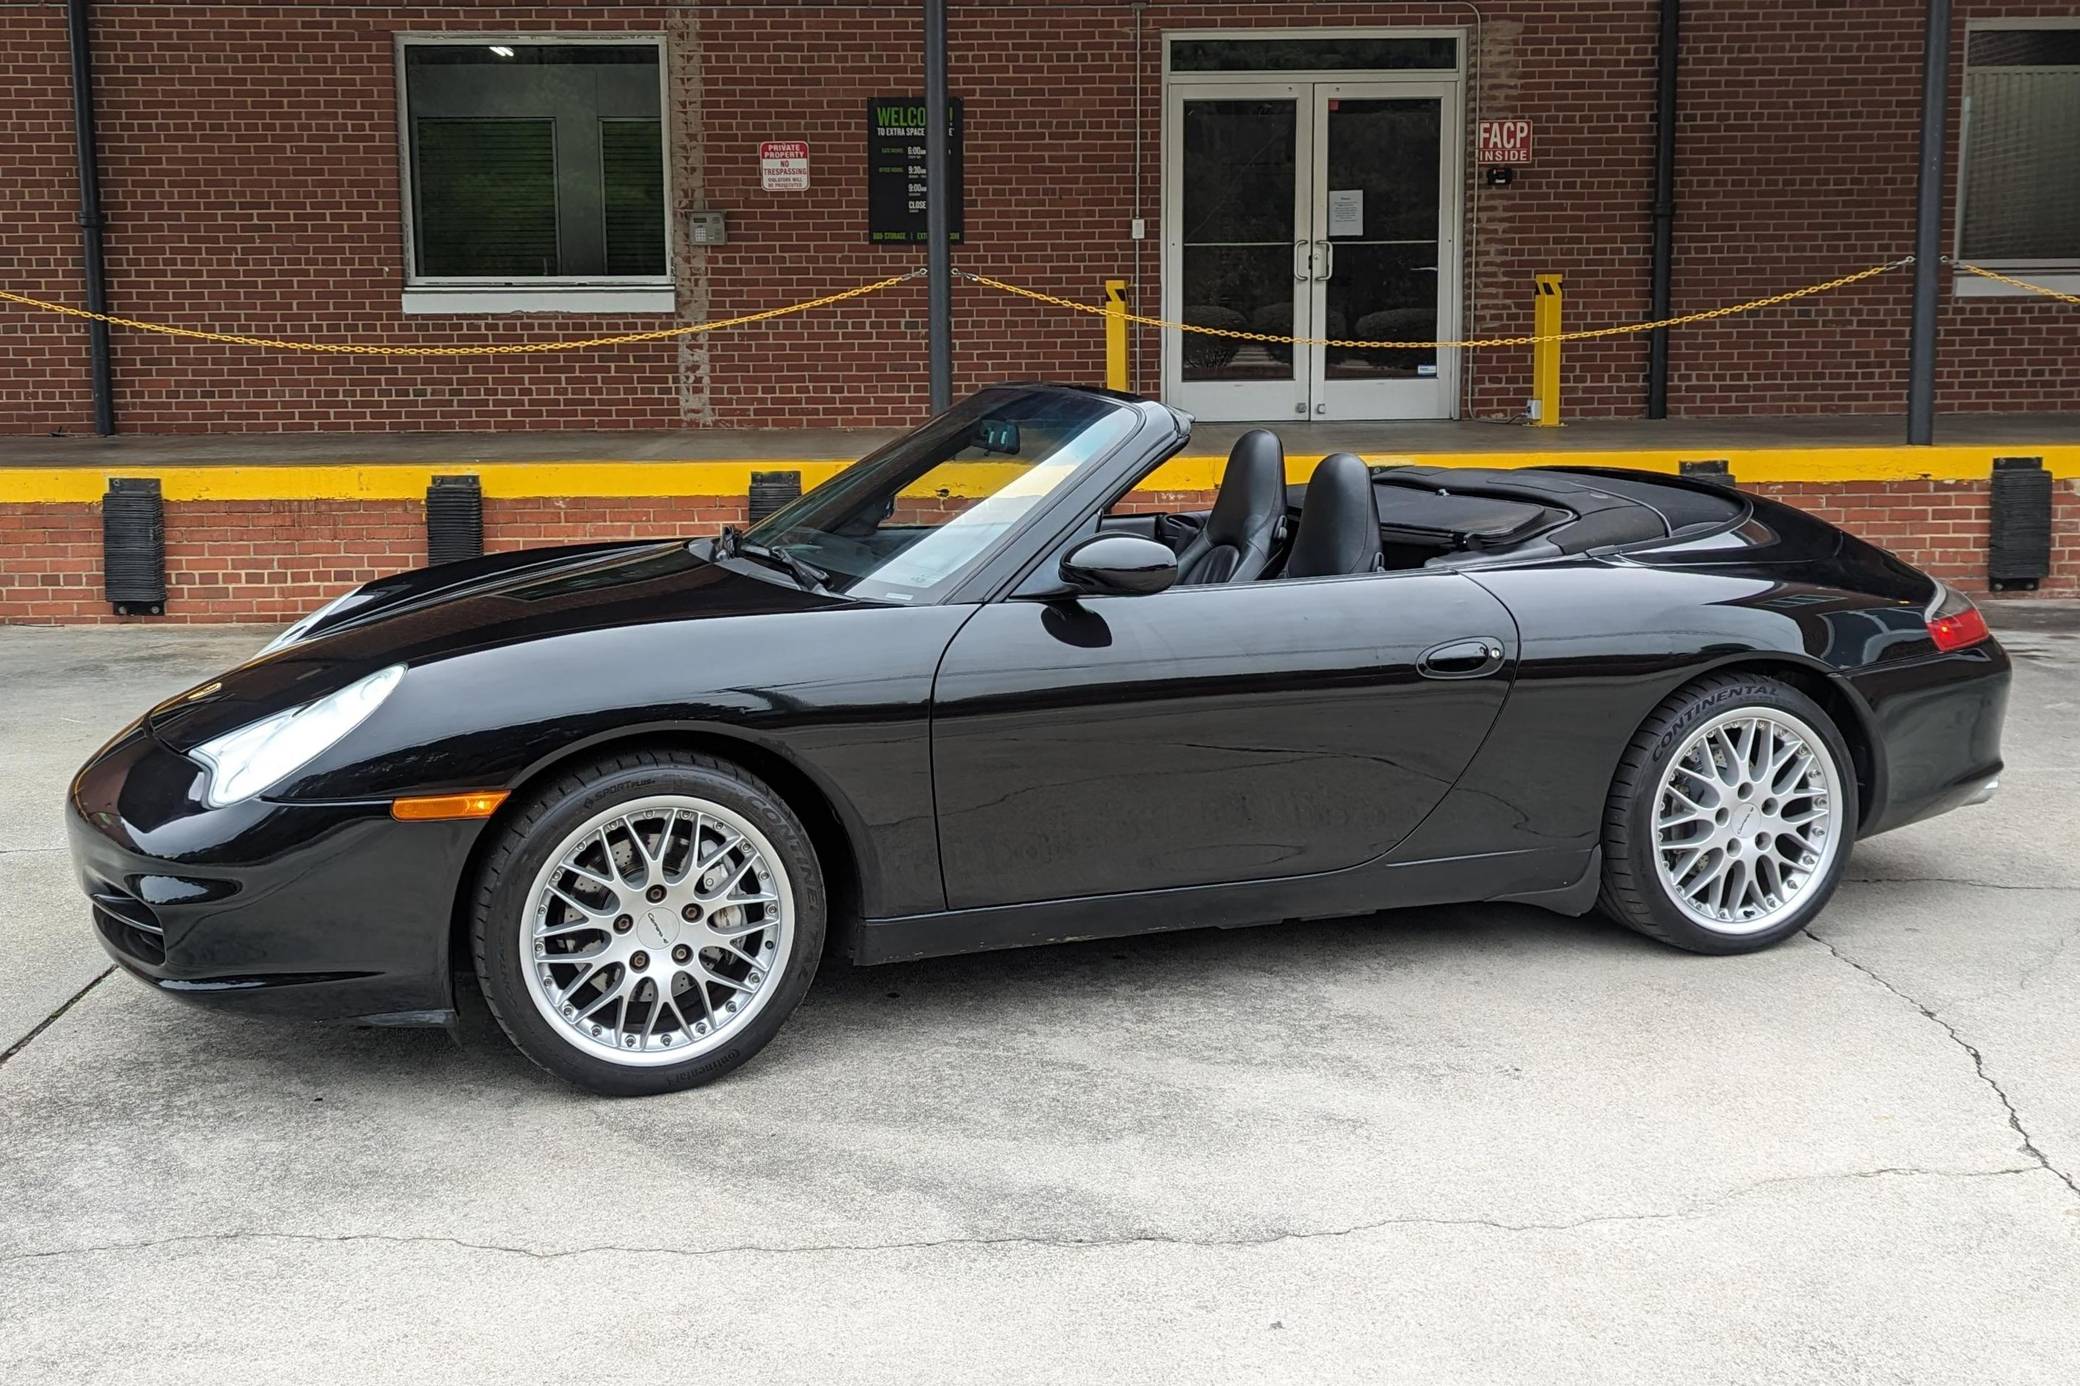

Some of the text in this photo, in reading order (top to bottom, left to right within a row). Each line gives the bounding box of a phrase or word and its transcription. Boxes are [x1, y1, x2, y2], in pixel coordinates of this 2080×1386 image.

[876, 106, 953, 126] WELCO!
[877, 127, 926, 137] TO EXTRA SPACE
[1479, 121, 1529, 149] FACP
[768, 144, 800, 152] PRIVATE
[1479, 150, 1527, 161] INSIDE
[780, 160, 790, 168] NO
[763, 167, 807, 176] TRESPASSING
[908, 200, 927, 209] CLOSE
[1652, 684, 1777, 762] CONTINENTAL
